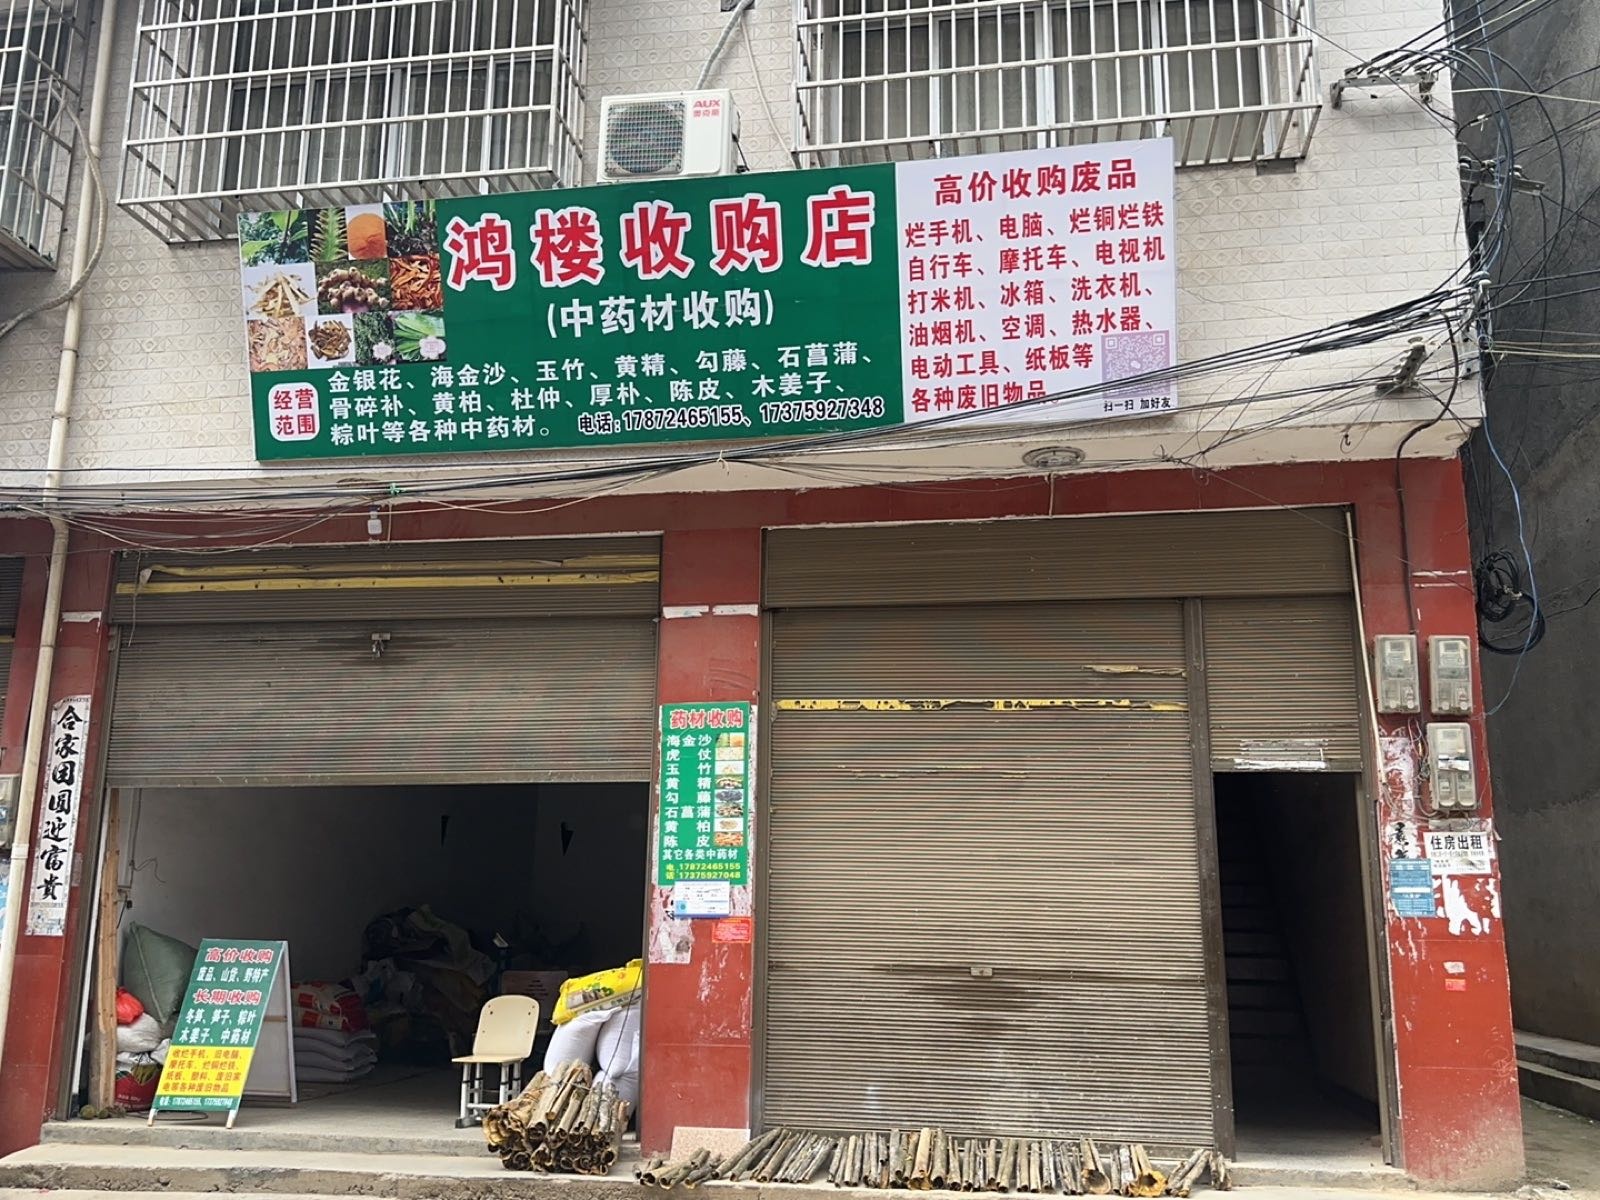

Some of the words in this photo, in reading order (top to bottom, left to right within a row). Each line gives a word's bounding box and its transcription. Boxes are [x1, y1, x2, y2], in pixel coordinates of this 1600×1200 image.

[692, 99, 721, 109] AUX
[933, 158, 1137, 206] 高价收购废品
[904, 200, 1165, 249] 烂手机、电脑、烂铜烂铁
[444, 186, 874, 291] 鸿楼收购店
[908, 236, 1166, 283] 自行车、摩托车、电视机
[907, 271, 1156, 315] 打米机、冰箱、洗衣机、
[547, 287, 774, 339] (中药材收购)
[908, 305, 1156, 348] 油烟机、空调、热水器、
[910, 342, 1094, 380] 电动工具、纸板等
[272, 388, 315, 411] 经营
[1103, 400, 1134, 412] 扫一扫
[1139, 397, 1171, 410] 加好友
[274, 413, 317, 436] 范围
[669, 708, 744, 730] 药材收购
[666, 733, 713, 748] 海金沙
[665, 762, 712, 776] 玉竹
[664, 819, 711, 833] 黄柏
[662, 834, 711, 848] 陈皮
[1430, 834, 1484, 851] 住房出租
[204, 947, 275, 964] 高价收购
[192, 988, 263, 1005] 长期收购
